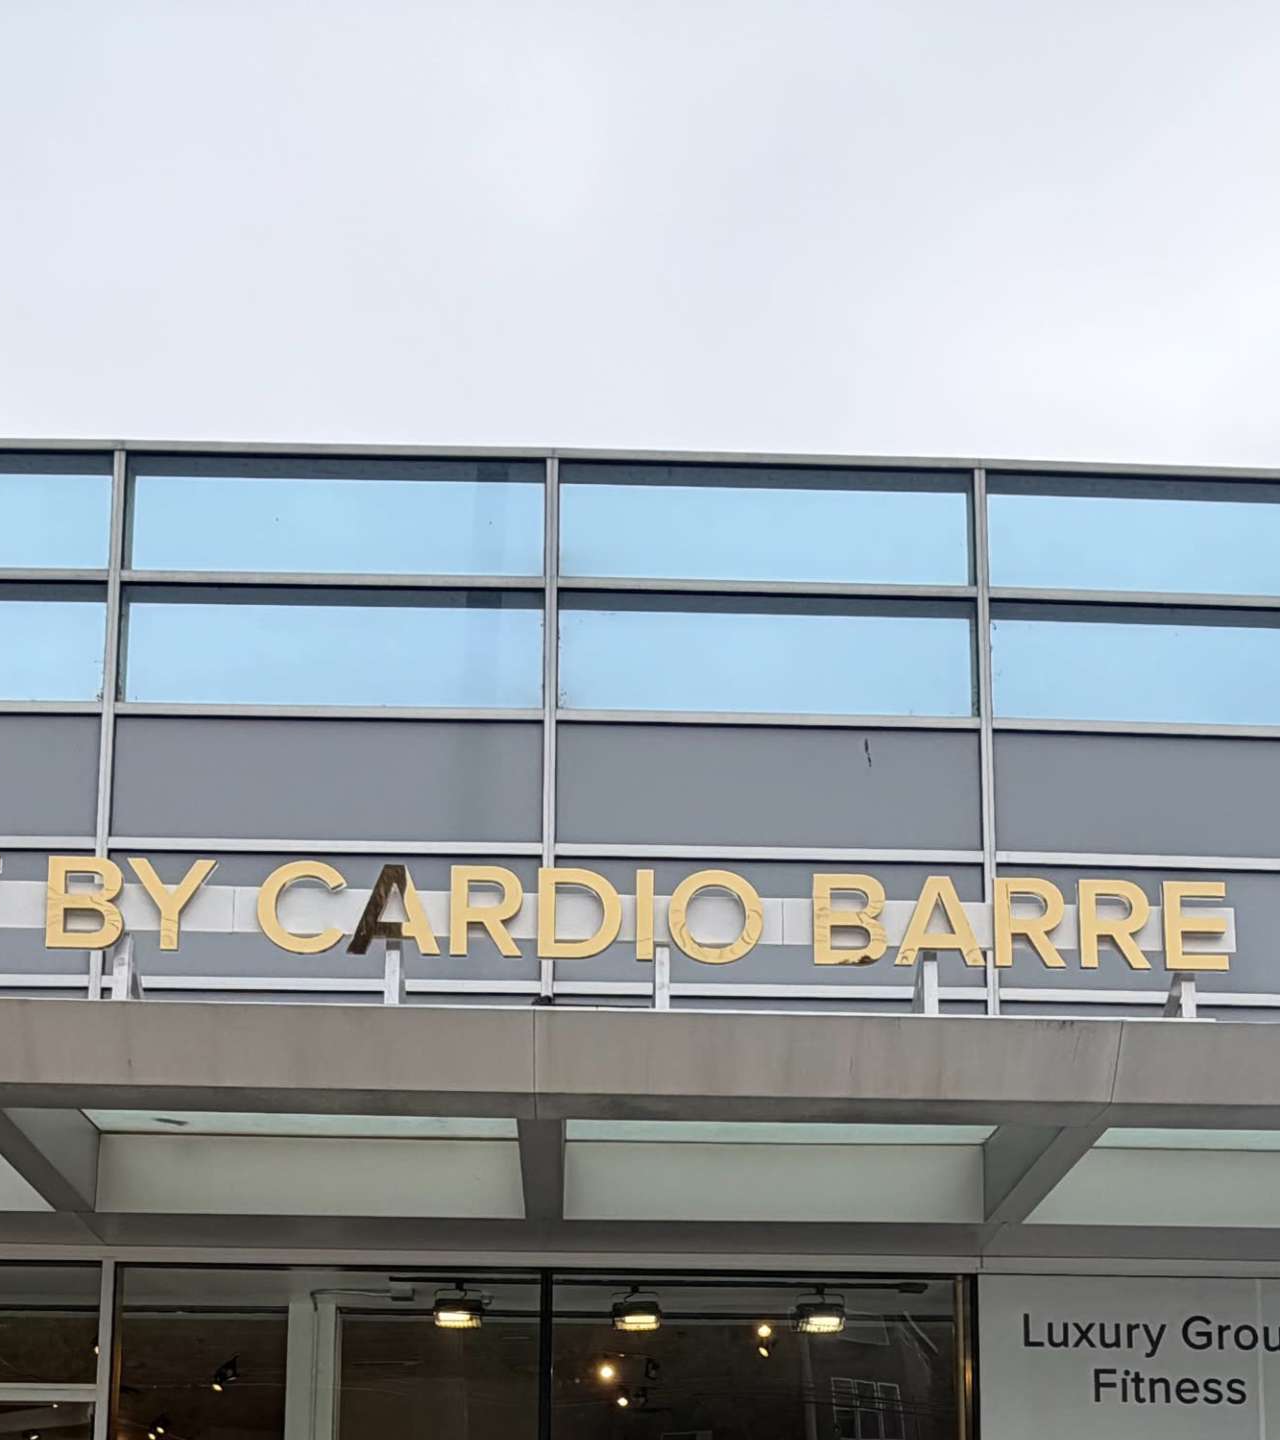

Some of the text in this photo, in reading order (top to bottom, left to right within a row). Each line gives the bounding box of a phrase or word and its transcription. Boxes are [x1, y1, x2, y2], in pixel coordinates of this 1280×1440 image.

[45, 855, 218, 952] BY
[256, 860, 764, 965] CARDIO
[812, 873, 1231, 972] BARRE
[1023, 1313, 1167, 1358] Luxury
[1093, 1368, 1248, 1405] Fitness
